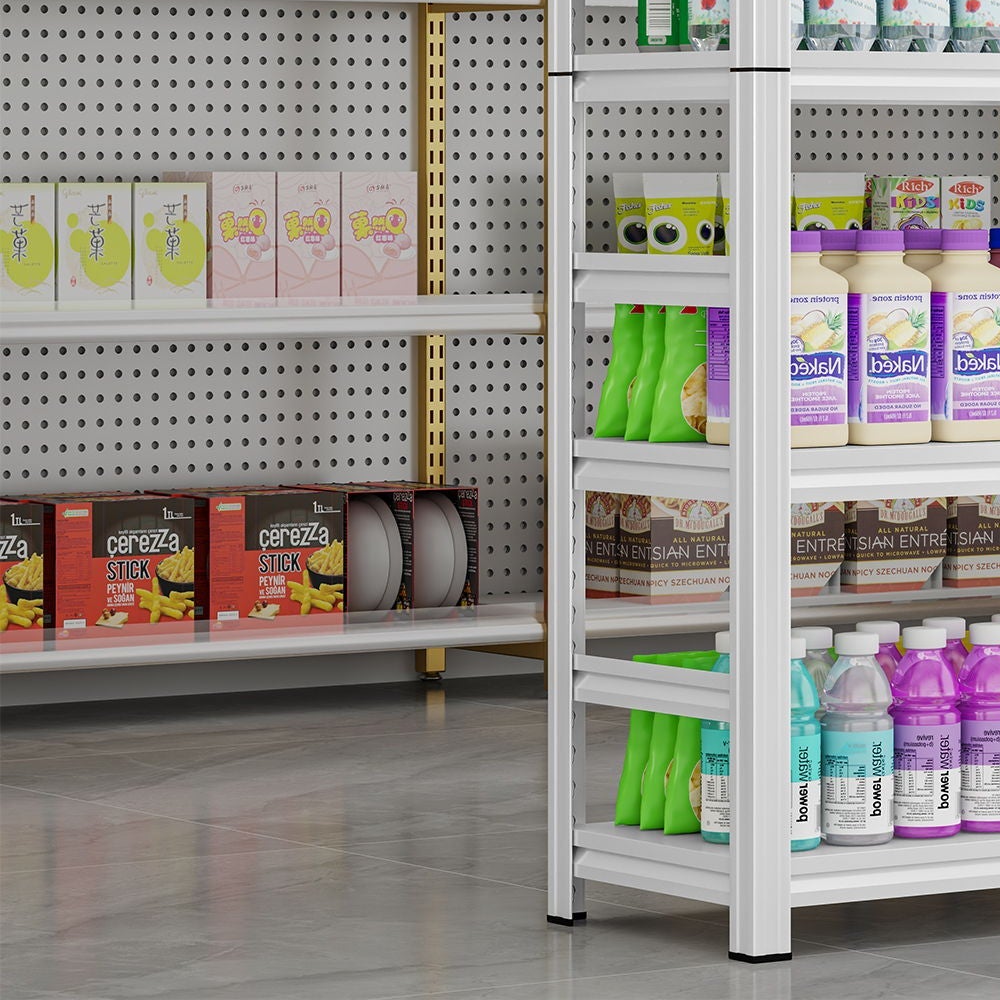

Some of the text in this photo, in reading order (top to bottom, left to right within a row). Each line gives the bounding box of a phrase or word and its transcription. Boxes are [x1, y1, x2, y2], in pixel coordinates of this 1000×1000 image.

[903, 181, 928, 191] Rich
[954, 183, 977, 194] Rich
[792, 530, 826, 538] NATURAL
[259, 553, 301, 573] STICK
[107, 560, 150, 580] STICK
[876, 567, 920, 575] SZECHUAN
[671, 578, 716, 586] SZECHUAN
